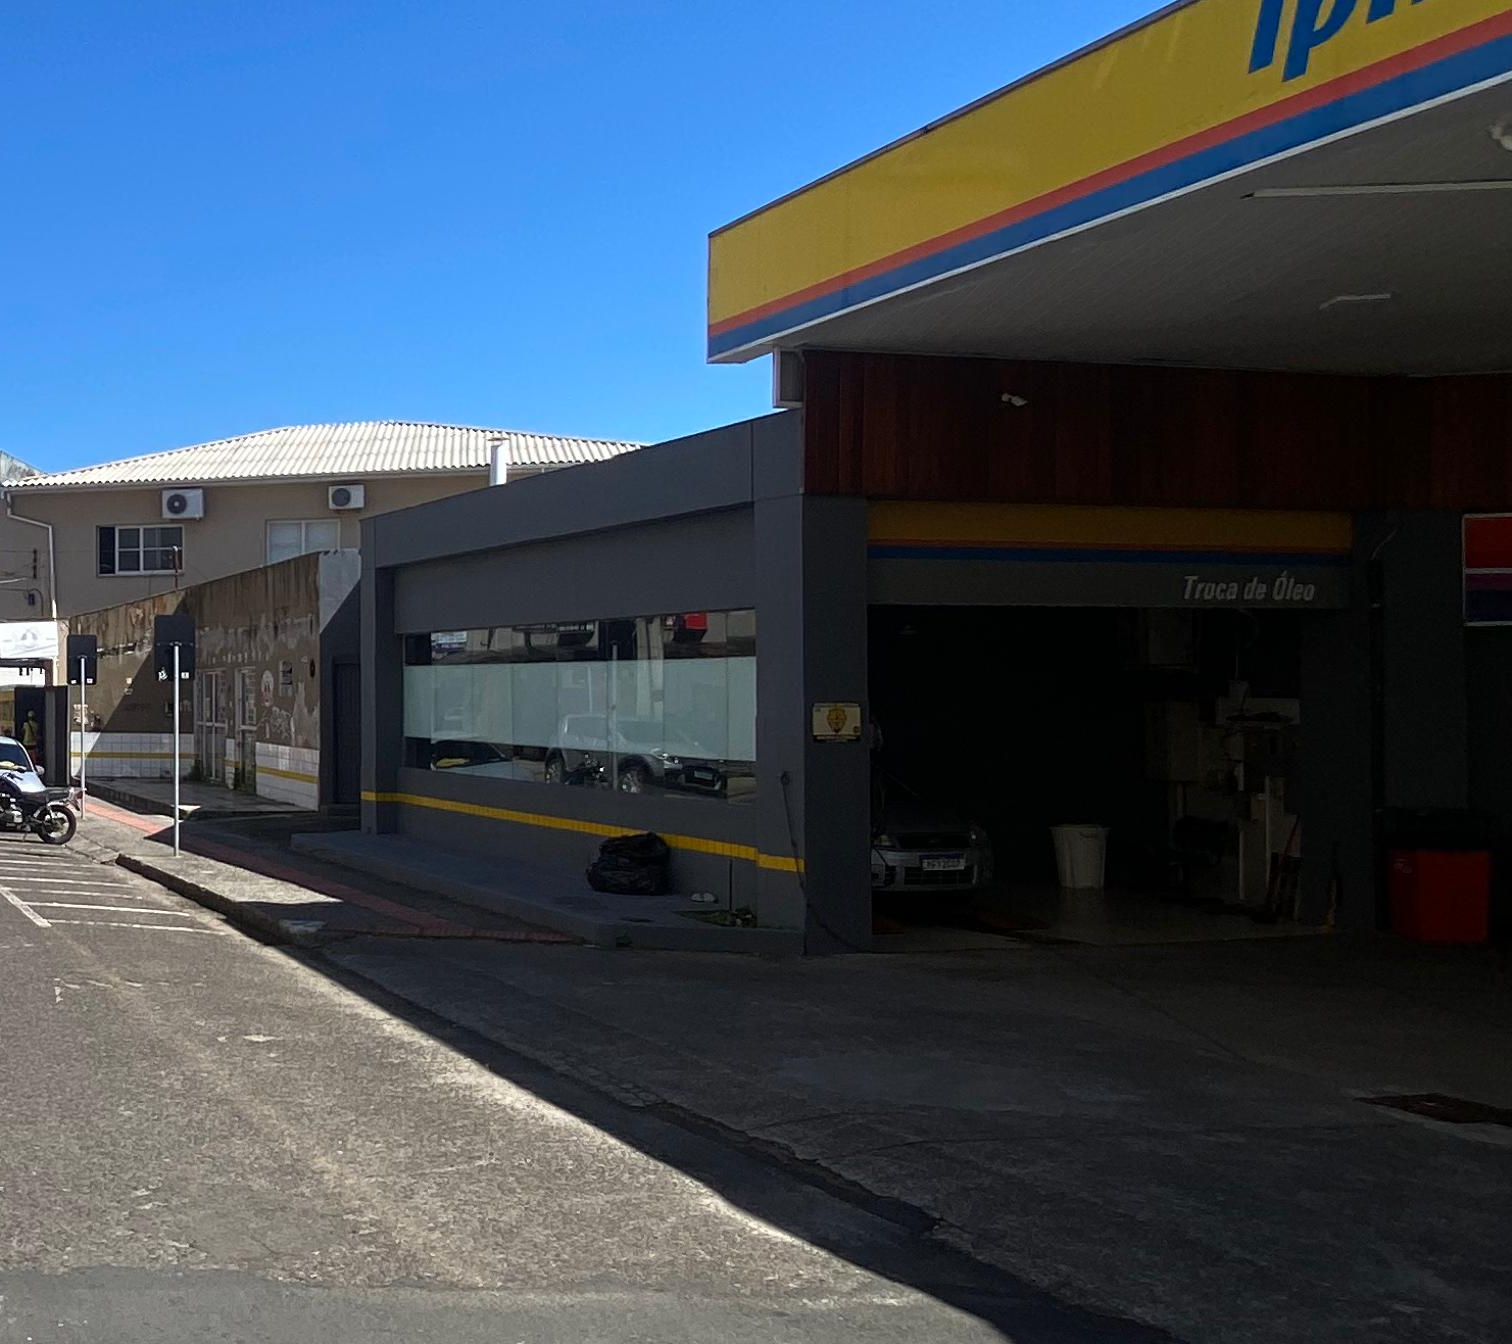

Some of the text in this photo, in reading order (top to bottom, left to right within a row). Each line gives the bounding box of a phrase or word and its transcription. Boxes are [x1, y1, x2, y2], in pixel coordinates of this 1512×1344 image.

[1183, 569, 1316, 601] Troca de Óleo
